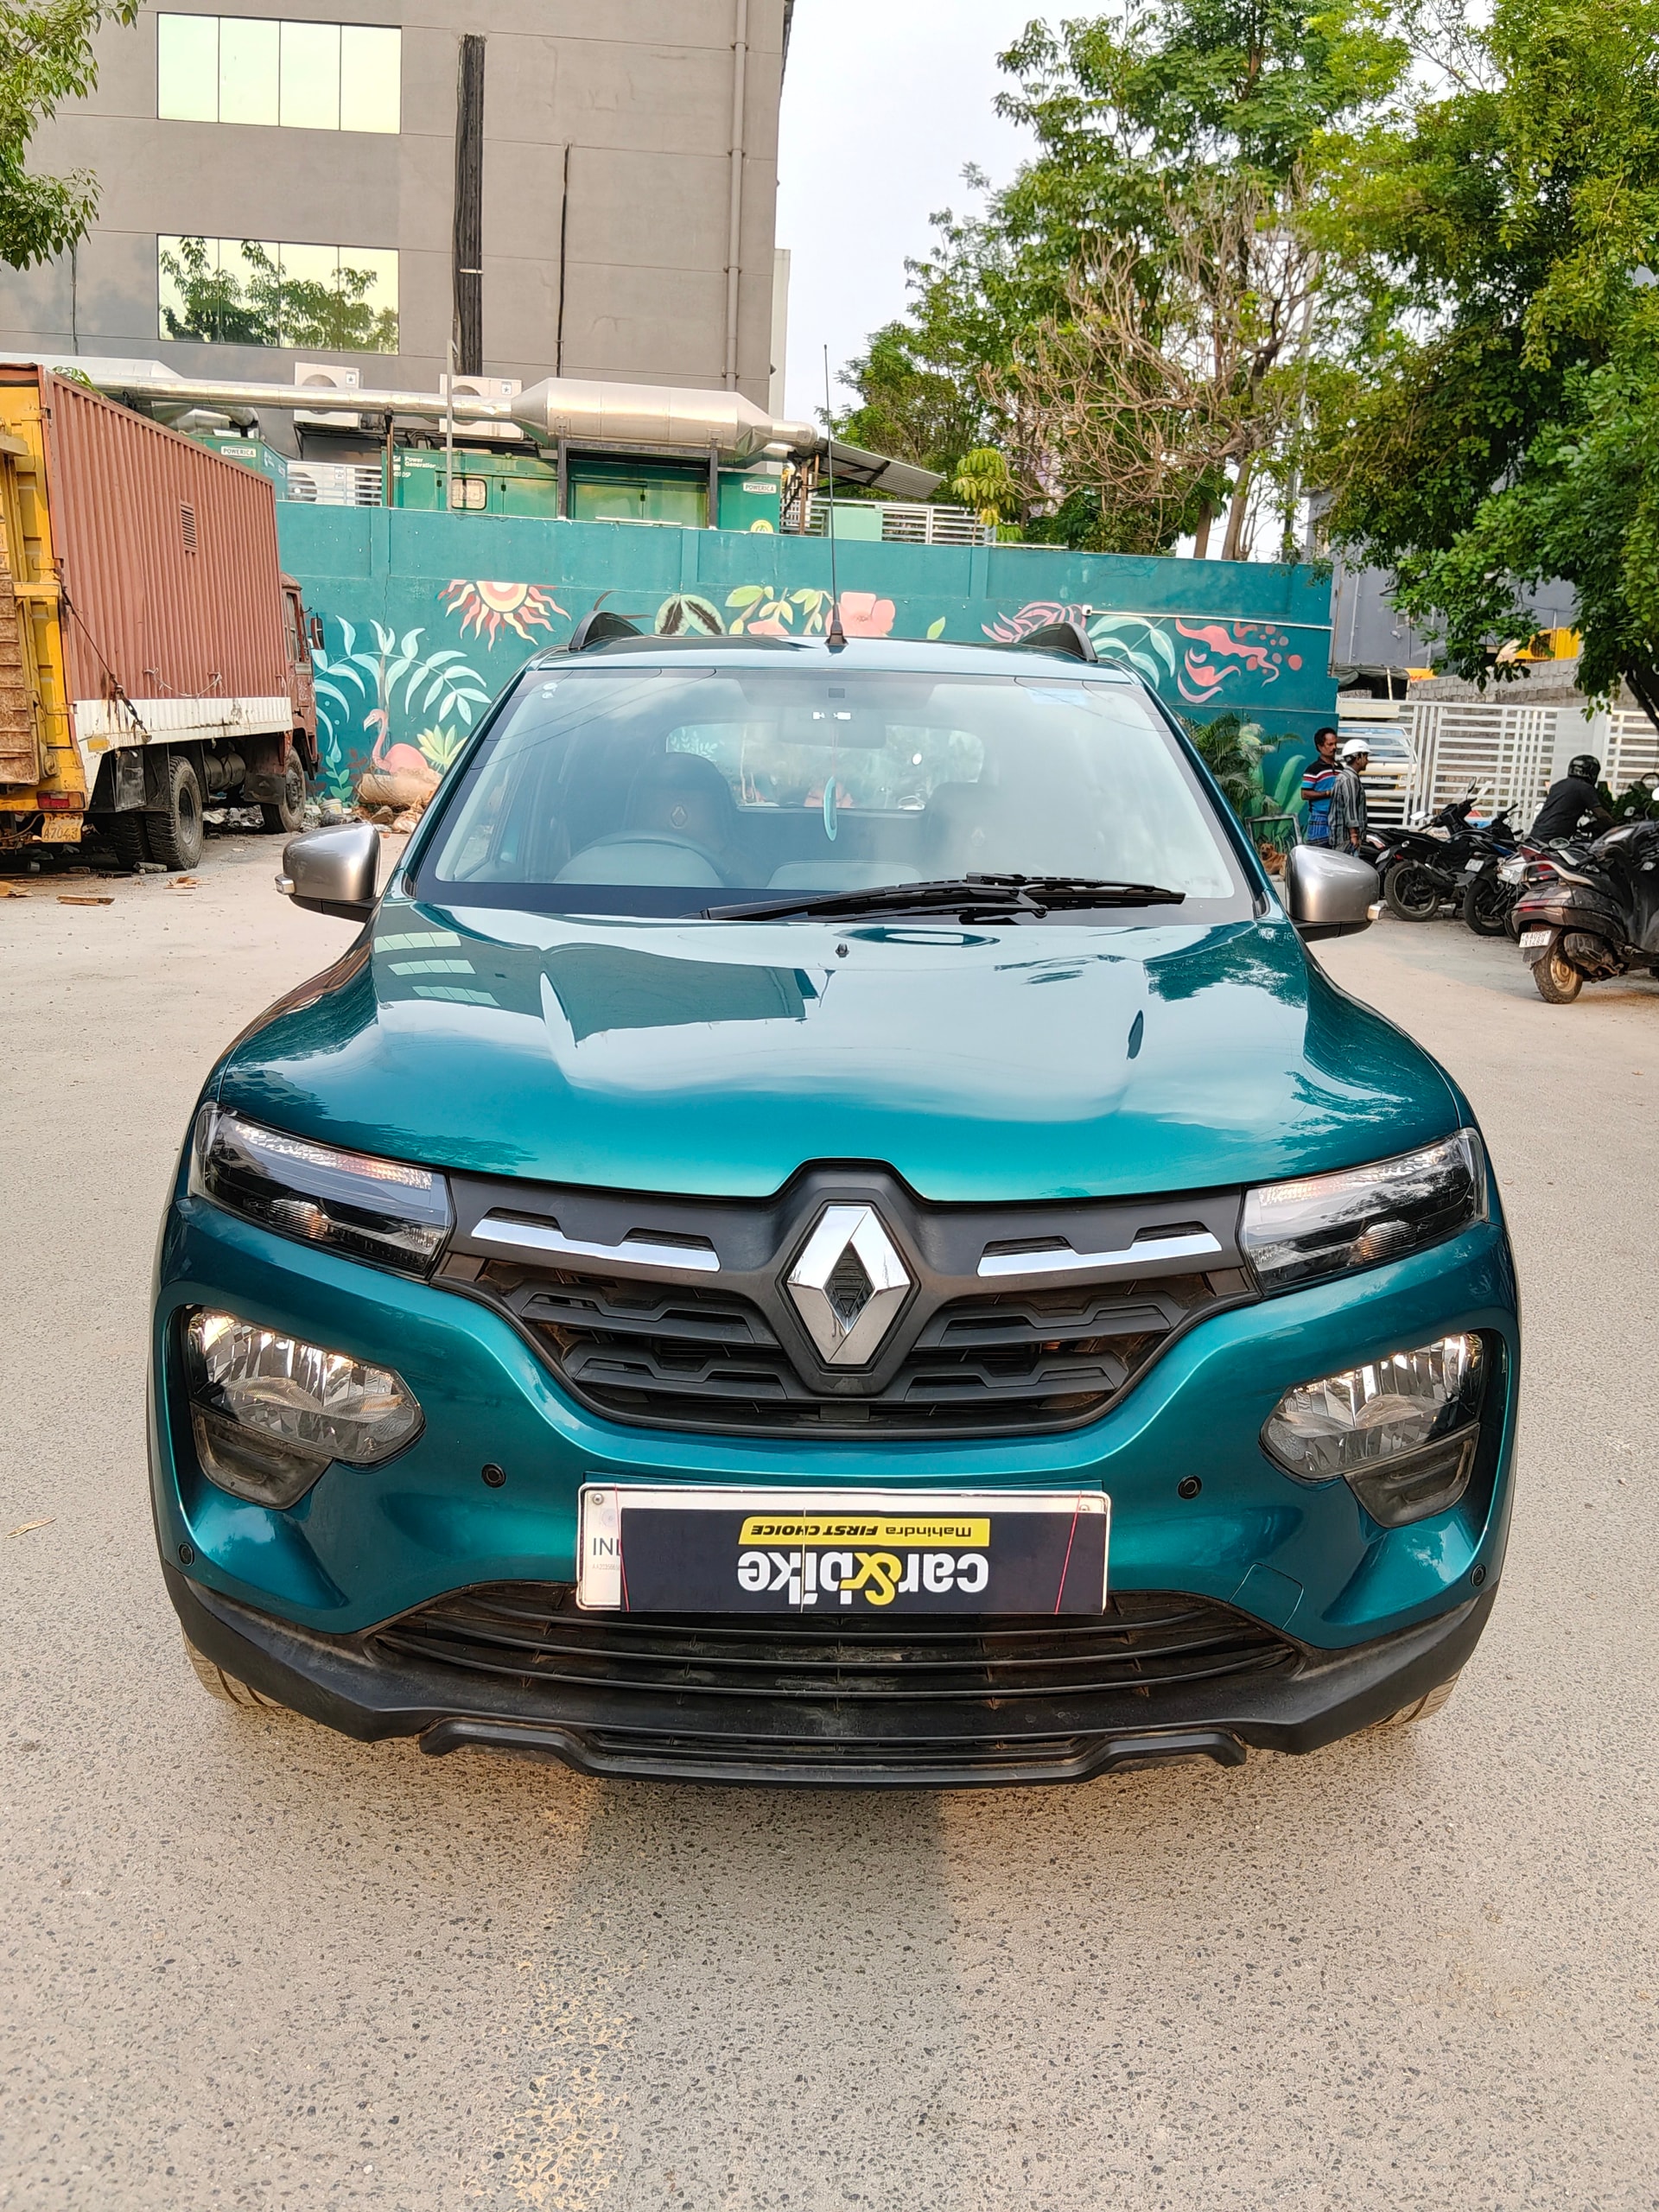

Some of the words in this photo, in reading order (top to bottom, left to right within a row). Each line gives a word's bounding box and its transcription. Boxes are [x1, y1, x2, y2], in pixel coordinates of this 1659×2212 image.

[223, 448, 254, 456] POWERICA
[751, 1524, 822, 1536] CHOICE
[823, 1525, 879, 1536] FIRST
[886, 1526, 972, 1537] Mahindra
[737, 1551, 989, 1605] car&bike
